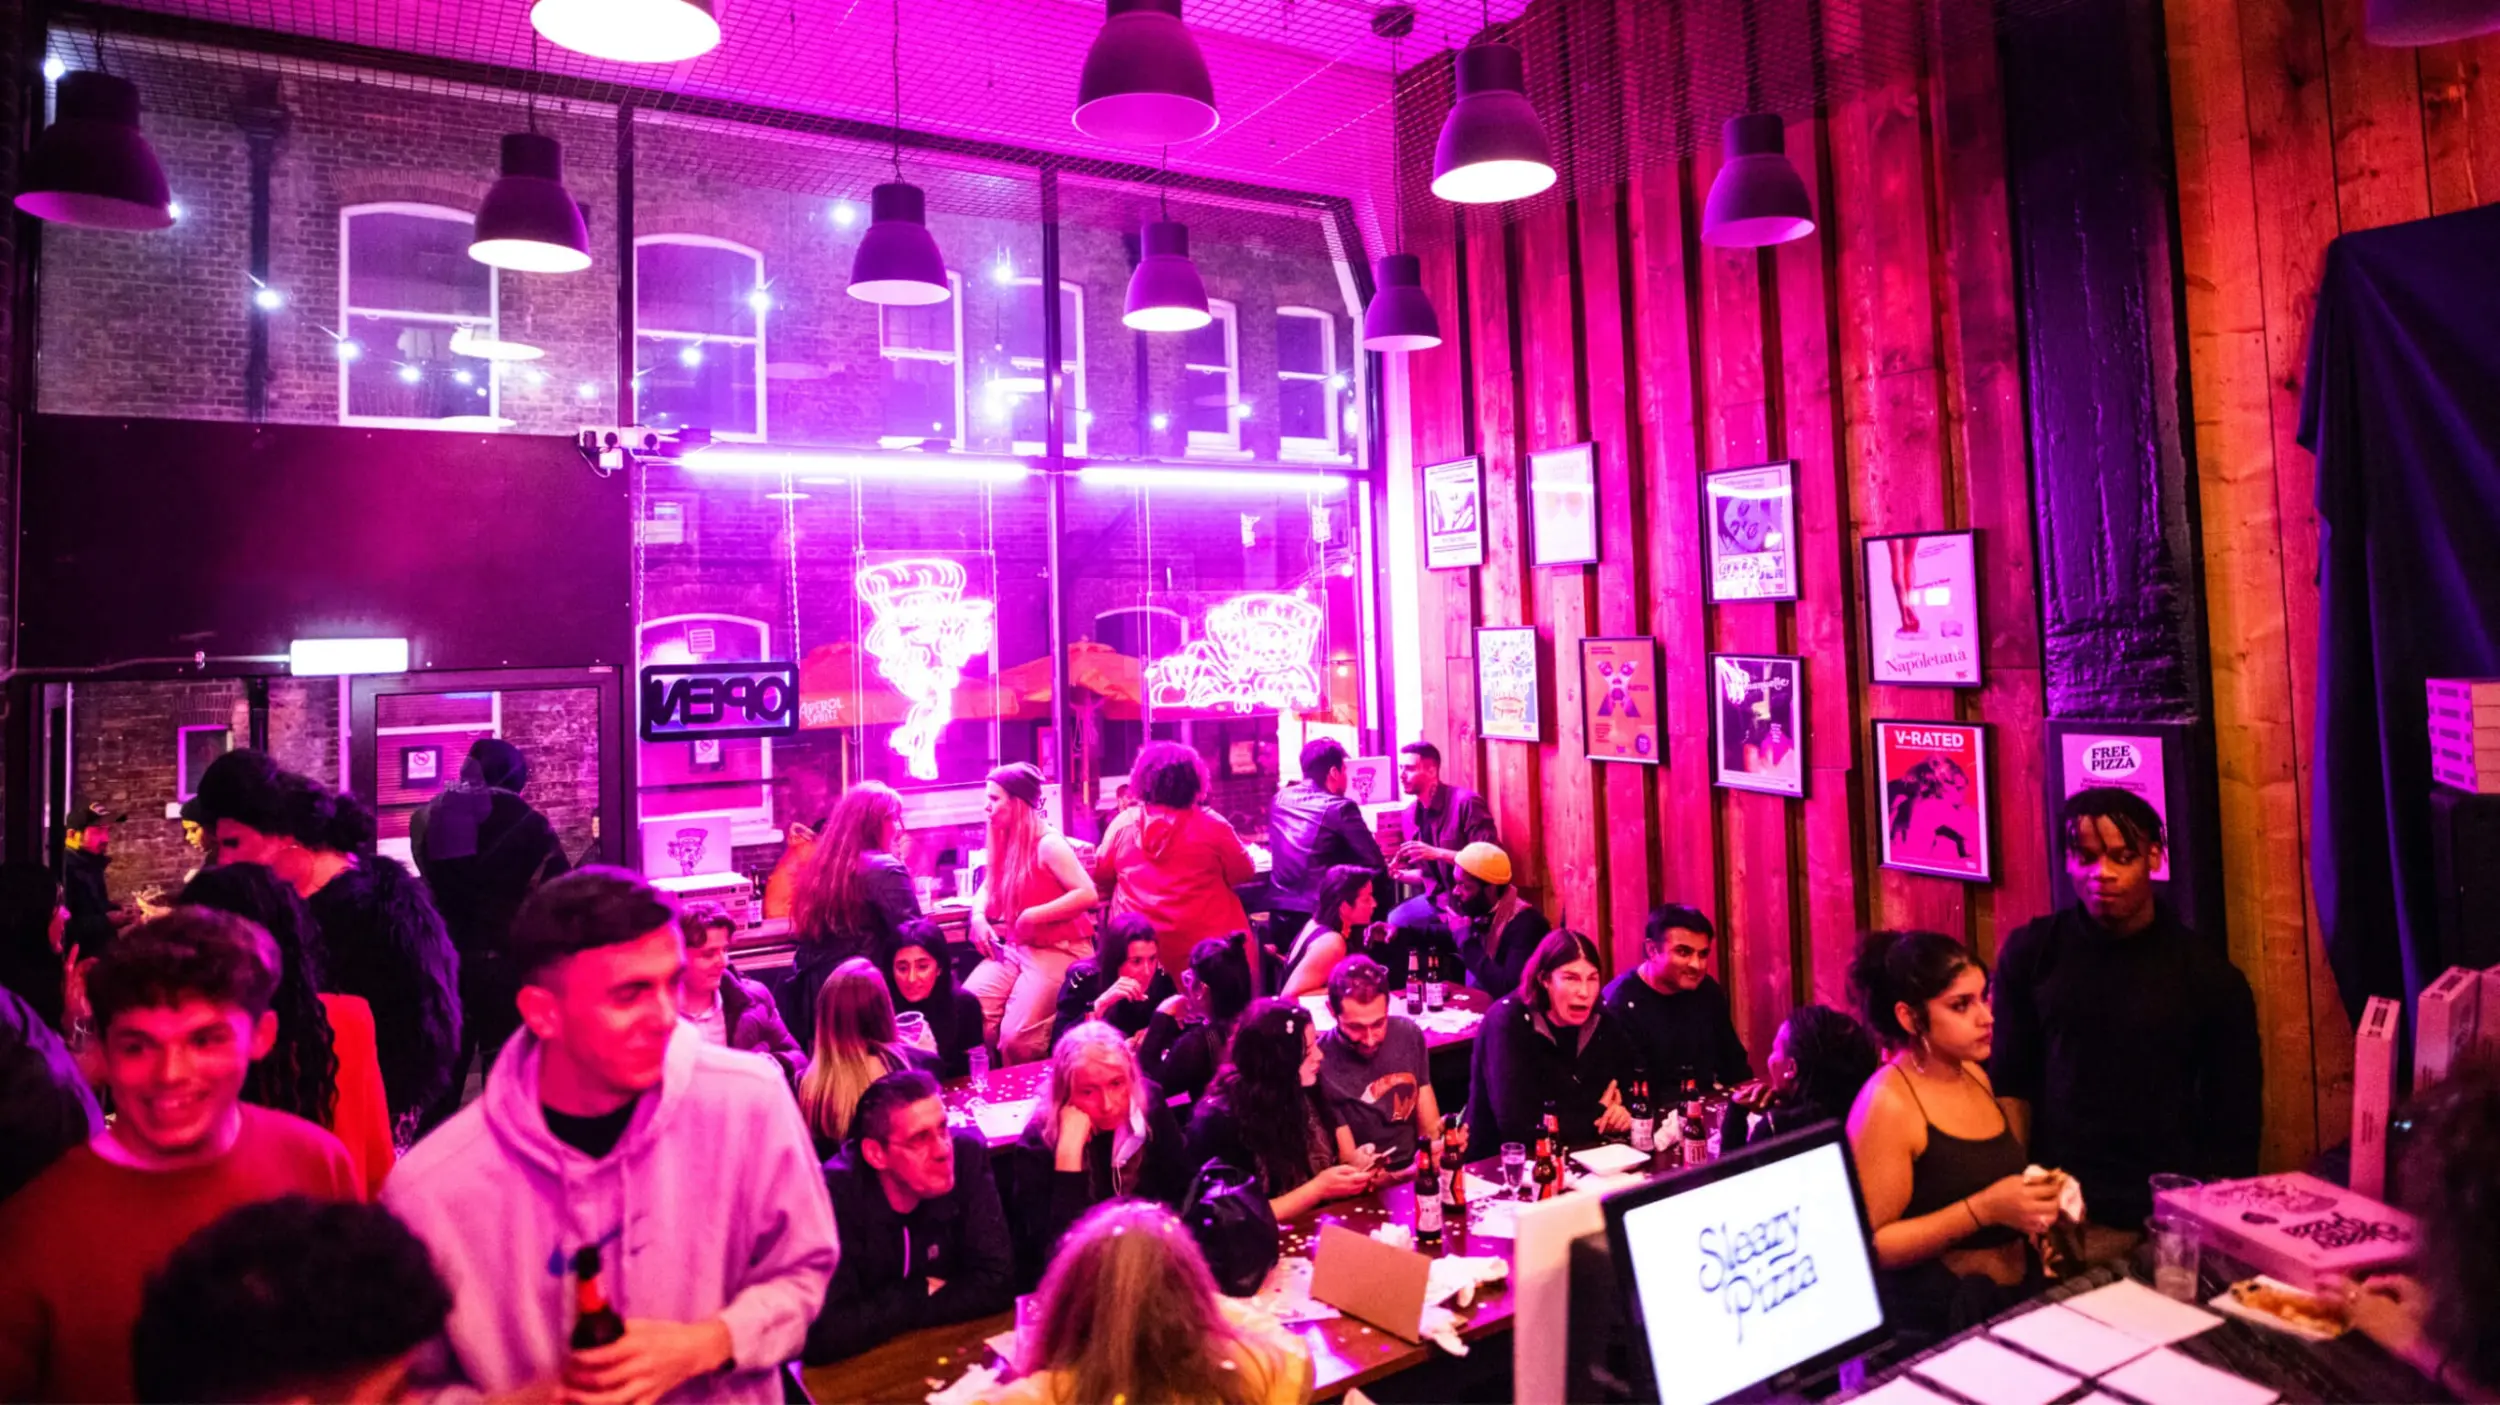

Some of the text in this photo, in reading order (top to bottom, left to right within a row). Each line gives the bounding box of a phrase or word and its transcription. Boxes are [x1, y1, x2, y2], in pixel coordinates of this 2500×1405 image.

[1885, 649, 1968, 676] Napoletana
[799, 697, 845, 721] APEROL
[1894, 730, 1965, 747] V-RATED
[2091, 745, 2131, 759] FREE
[2091, 757, 2136, 771] PIZZA
[1699, 1205, 1801, 1293] Sleazy
[1724, 1254, 1818, 1344] Pizza
